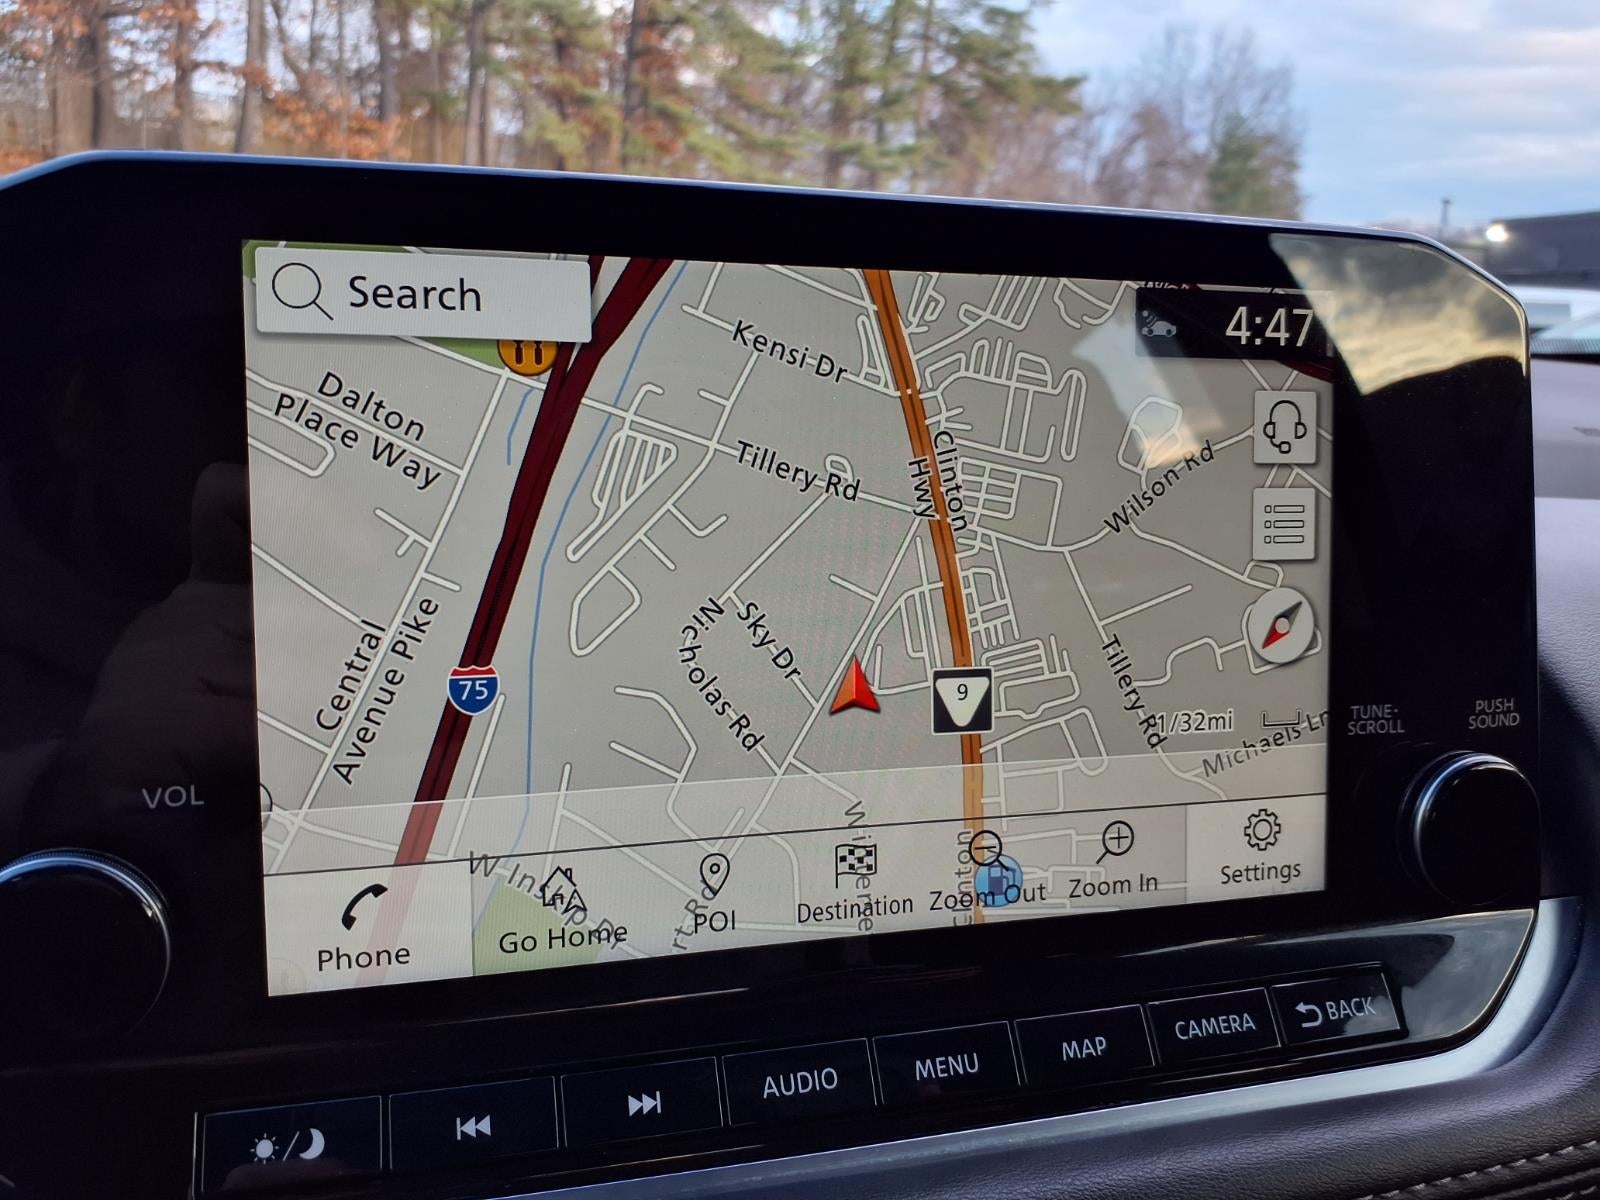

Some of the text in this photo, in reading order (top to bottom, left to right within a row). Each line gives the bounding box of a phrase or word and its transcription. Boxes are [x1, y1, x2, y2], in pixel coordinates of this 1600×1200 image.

[349, 275, 482, 312] Search
[1226, 306, 1313, 347] 4:47
[732, 320, 848, 383] Kensi Dr
[317, 371, 425, 441] Dalton
[274, 393, 441, 492] Place Way
[736, 440, 860, 501] Tillery Rd
[933, 430, 968, 532] Clinton
[908, 457, 935, 520] Hwy
[1104, 440, 1215, 534] Wilson Rd
[736, 602, 801, 679] Sky Dr
[316, 619, 387, 730] Central
[332, 597, 439, 785] Avenue Pike
[458, 680, 488, 700] 75
[957, 683, 968, 701] 9
[1102, 633, 1168, 749] Tillery Rd
[1475, 698, 1514, 713] PUSH
[728, 714, 765, 752] Rd
[1157, 710, 1232, 734] 1/32mi
[1347, 719, 1405, 735] SCROLL
[1468, 713, 1520, 729] SOUND
[1202, 727, 1301, 778] Michaels
[142, 785, 205, 809] VOL
[470, 850, 500, 877] W
[1221, 862, 1302, 886] Settings
[929, 883, 1047, 911] Zoom Out
[1068, 873, 1158, 899] Zoom In
[694, 910, 735, 934] POI
[798, 896, 914, 923] Destination
[499, 925, 628, 954] Go Home
[318, 947, 411, 971] Phone
[1327, 996, 1377, 1020] BACK
[1175, 1012, 1256, 1041] CAMERA
[1062, 1036, 1107, 1062] MAP
[915, 1052, 979, 1081] MENU
[763, 1067, 838, 1099] AUDIO
